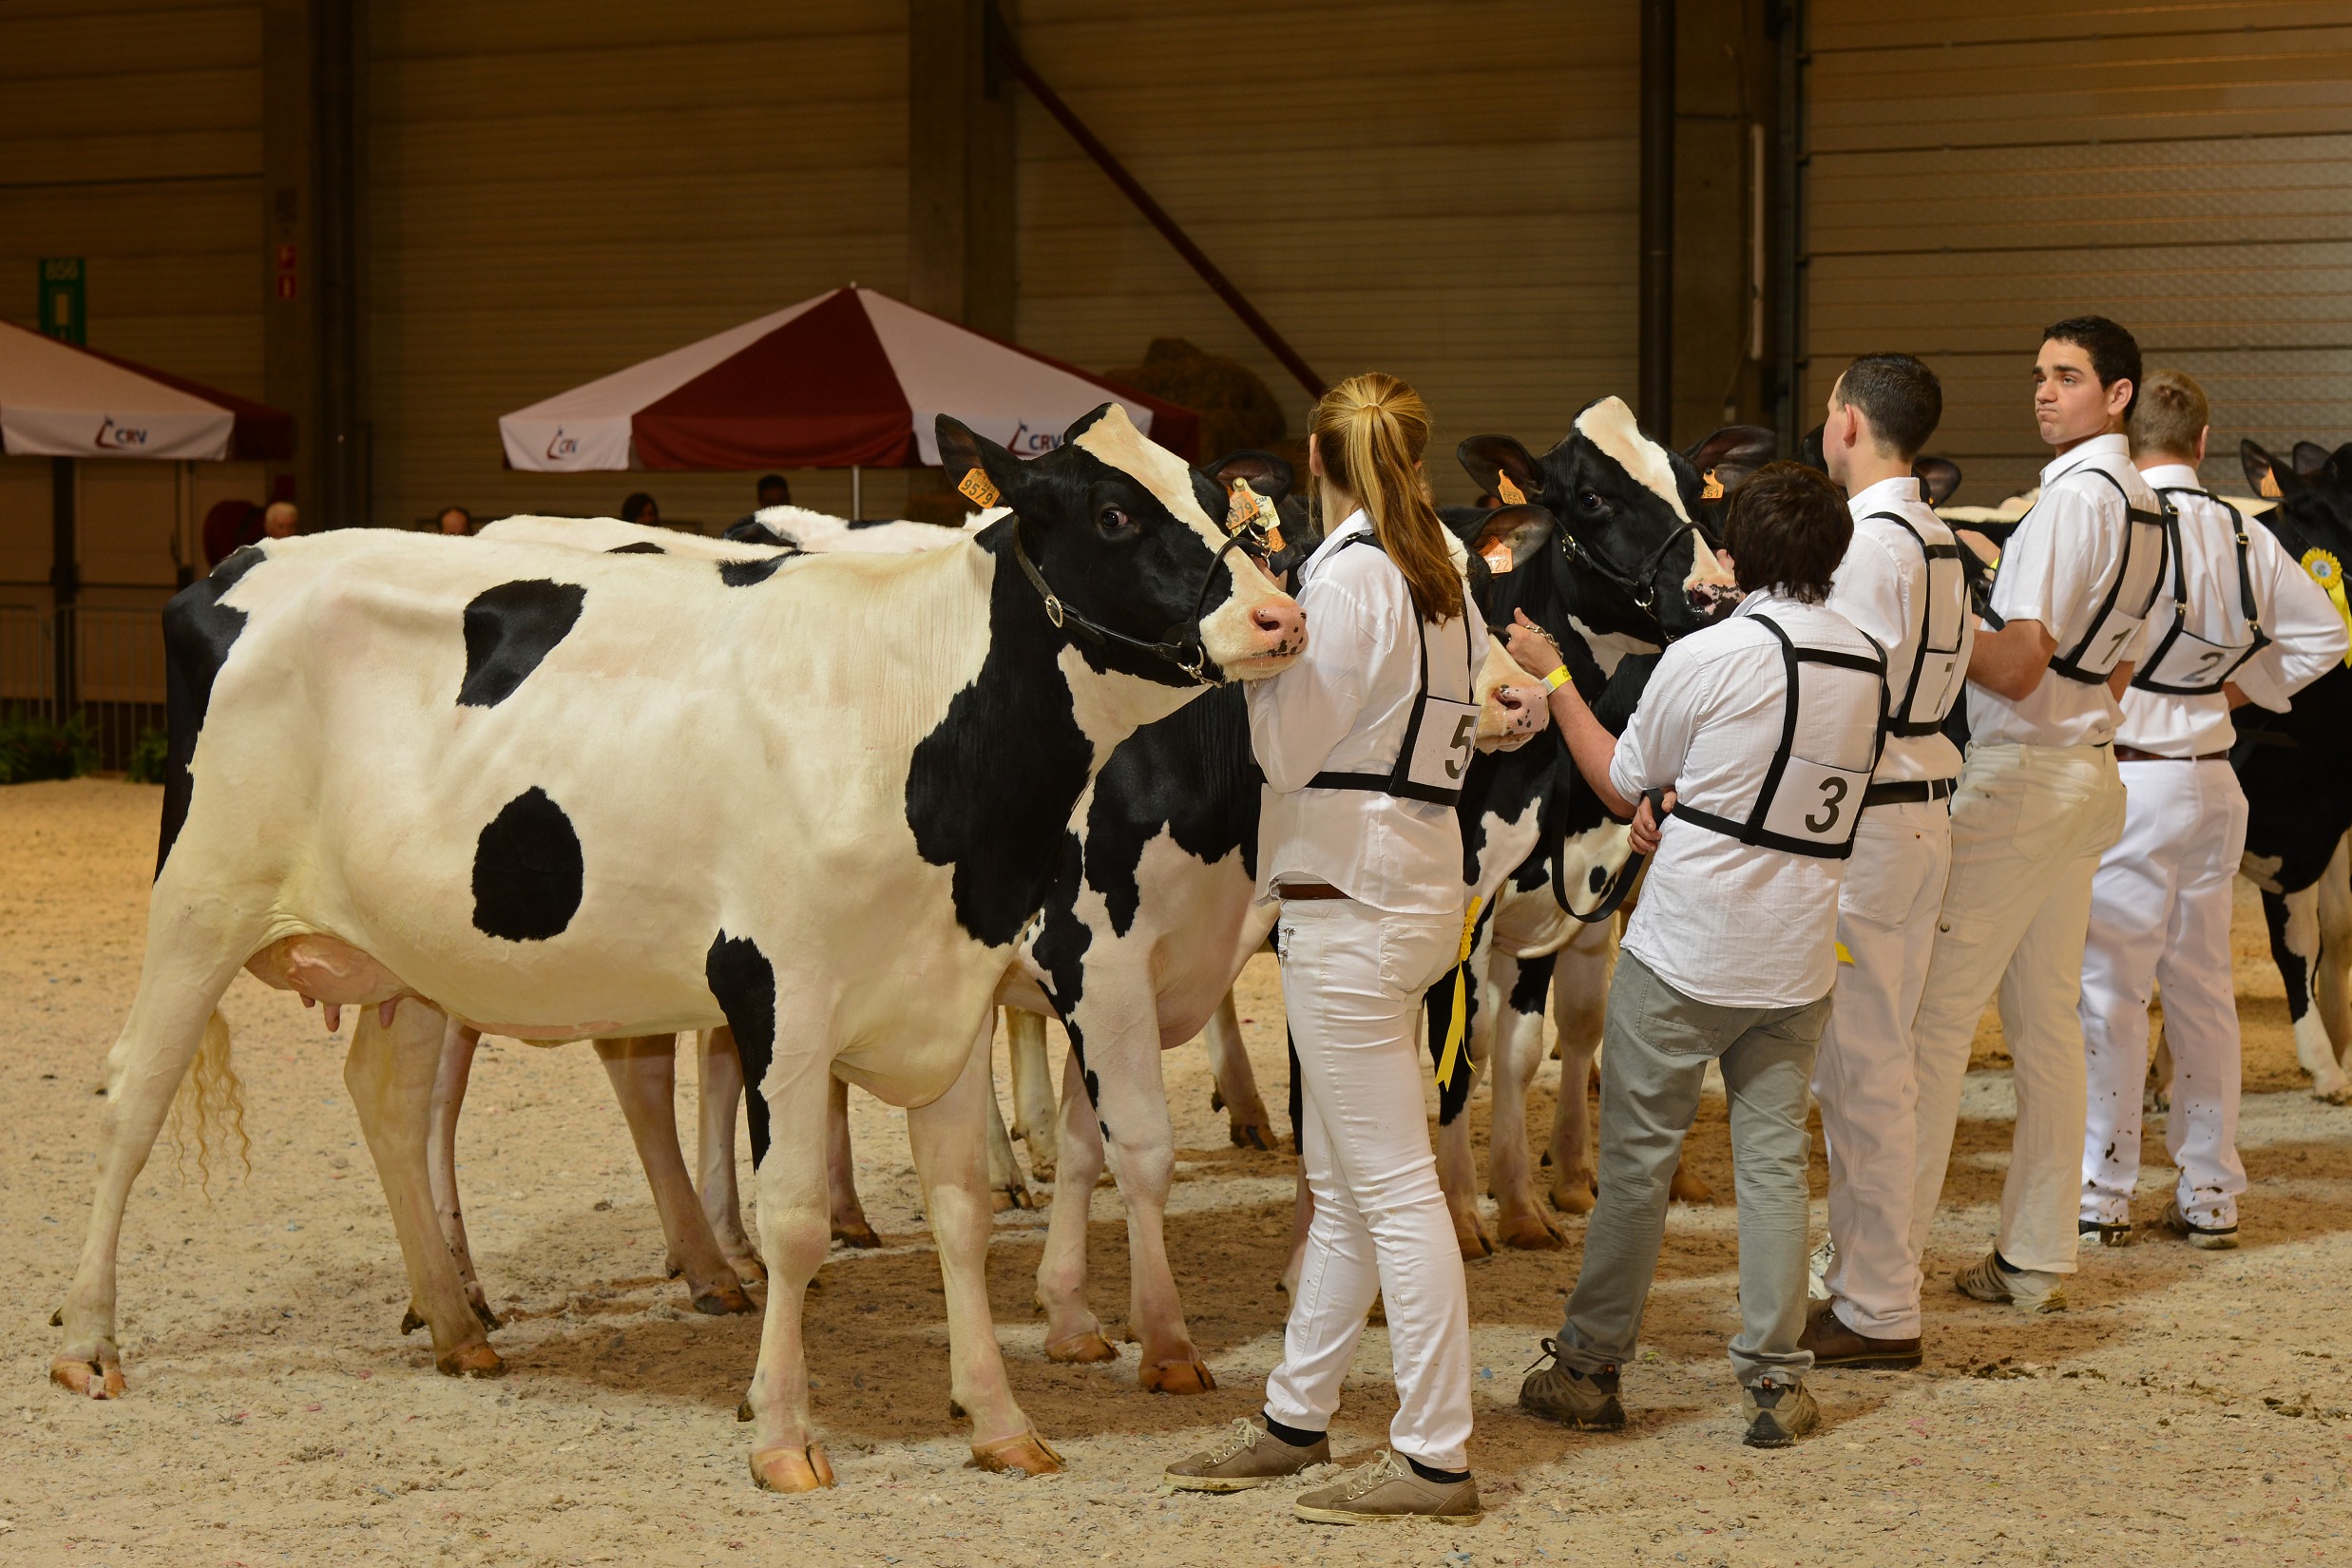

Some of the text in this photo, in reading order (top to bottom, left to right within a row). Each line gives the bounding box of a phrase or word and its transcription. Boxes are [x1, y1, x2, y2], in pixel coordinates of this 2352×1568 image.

[115, 428, 147, 445] CRV
[1029, 433, 1062, 450] CRV
[961, 479, 994, 506] 9579
[2101, 628, 2132, 665] 1
[2179, 651, 2226, 683] 2
[1444, 714, 1478, 779] 5
[1805, 776, 1847, 833] 3
